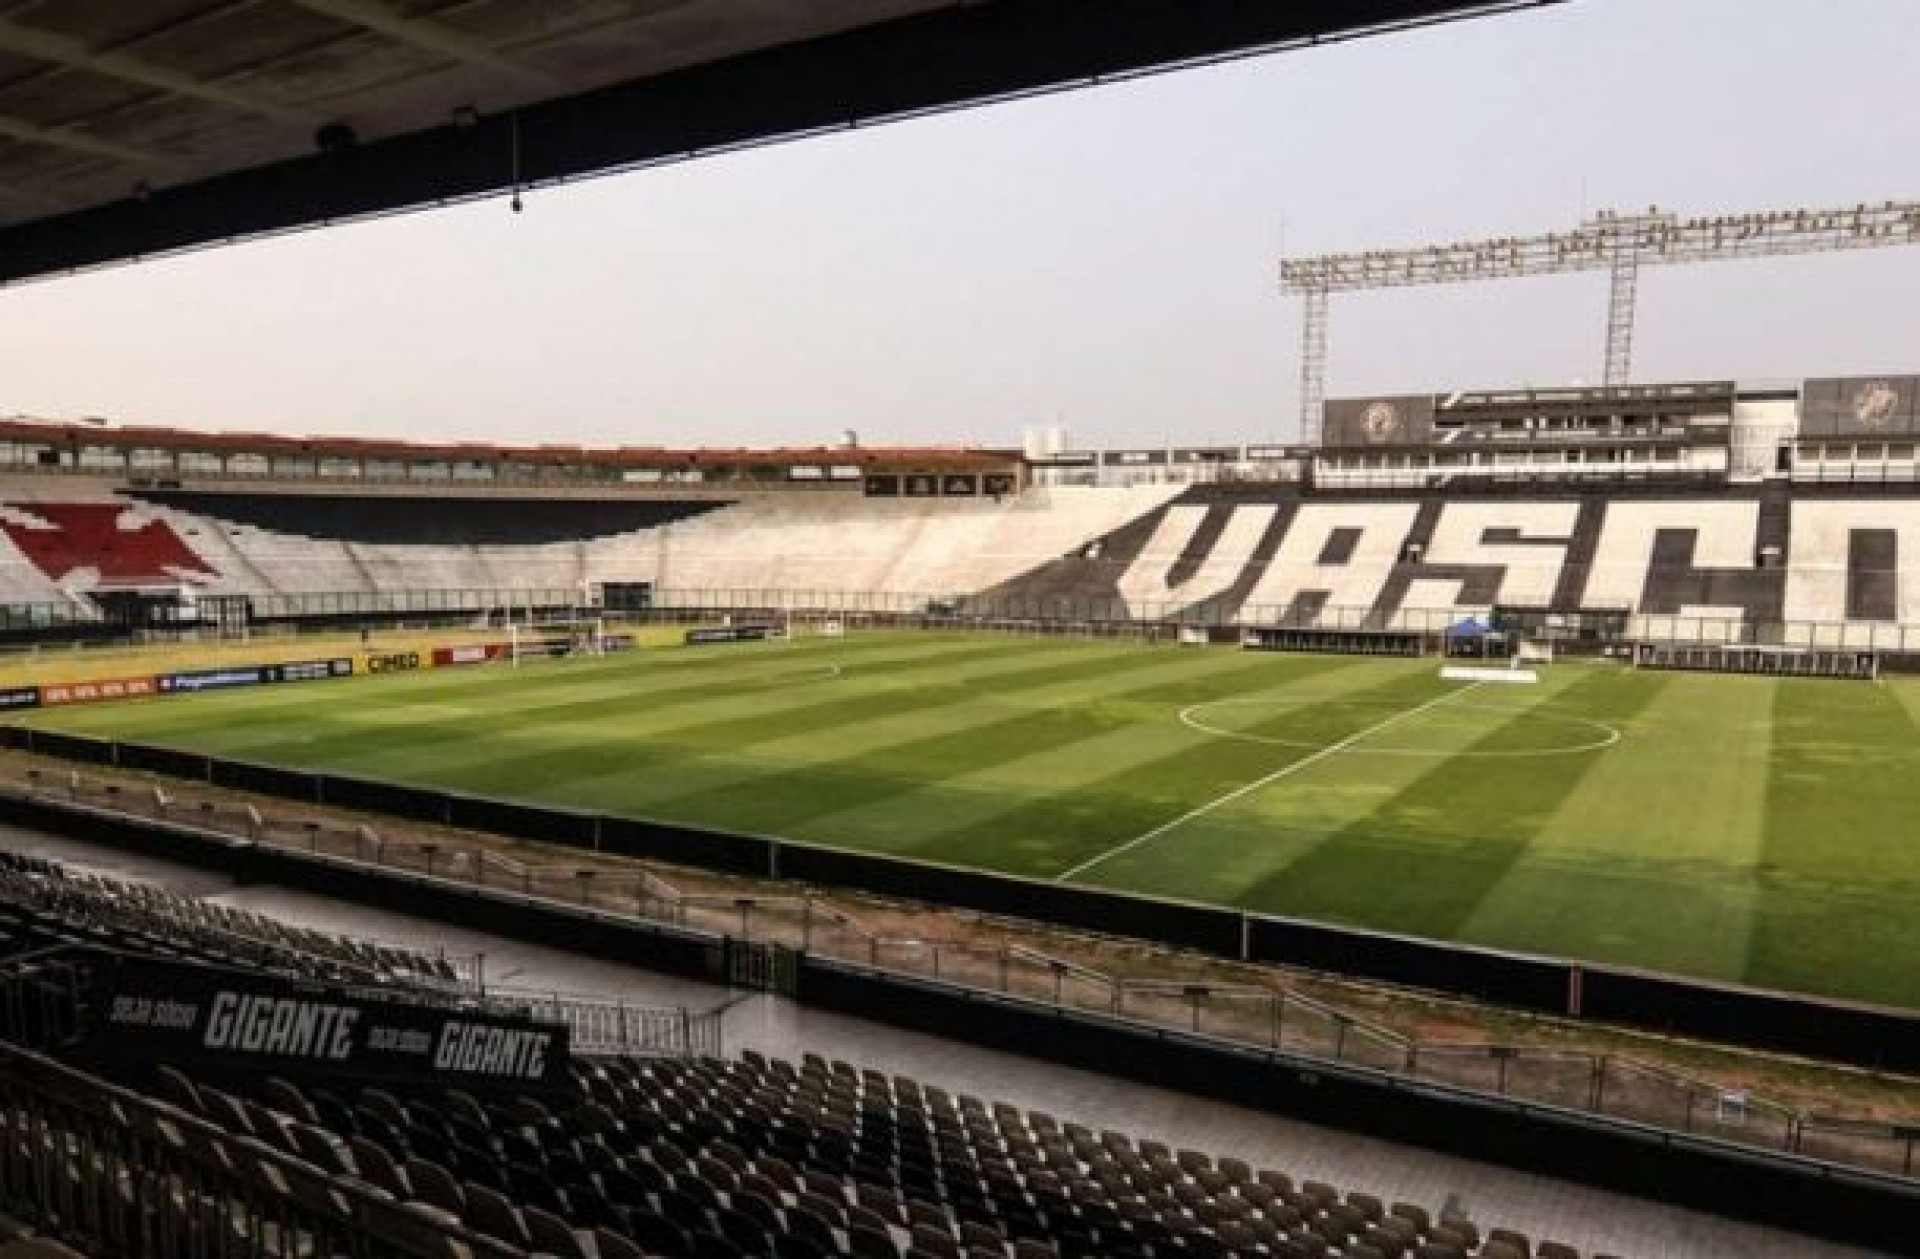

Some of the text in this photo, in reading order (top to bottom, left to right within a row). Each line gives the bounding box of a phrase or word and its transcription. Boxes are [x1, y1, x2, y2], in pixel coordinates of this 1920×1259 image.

[1114, 502, 1920, 646] VASCO
[204, 991, 359, 1059] GIGANTE
[434, 1022, 551, 1080] GIGANTE
